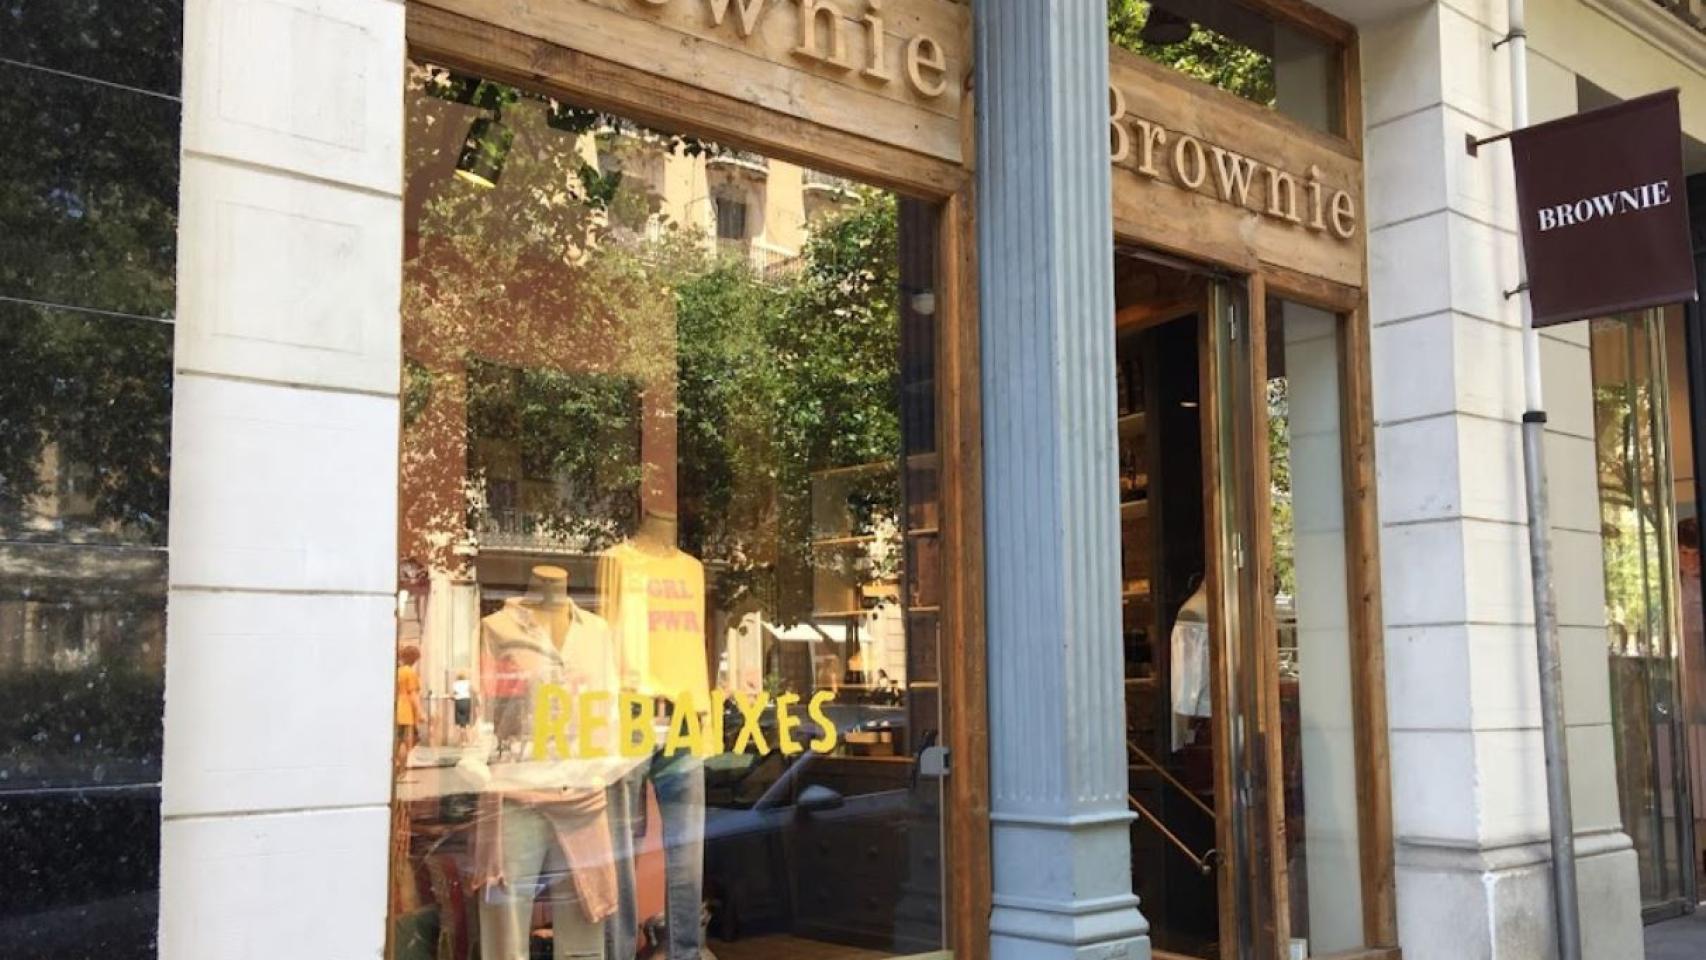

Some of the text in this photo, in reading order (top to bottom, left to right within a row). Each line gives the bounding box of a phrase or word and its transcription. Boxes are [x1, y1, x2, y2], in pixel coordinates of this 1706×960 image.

[1538, 180, 1671, 231] BROWNIE
[647, 578, 694, 599] GRL
[648, 610, 700, 632] PWR
[533, 683, 837, 761] REBAIXES
